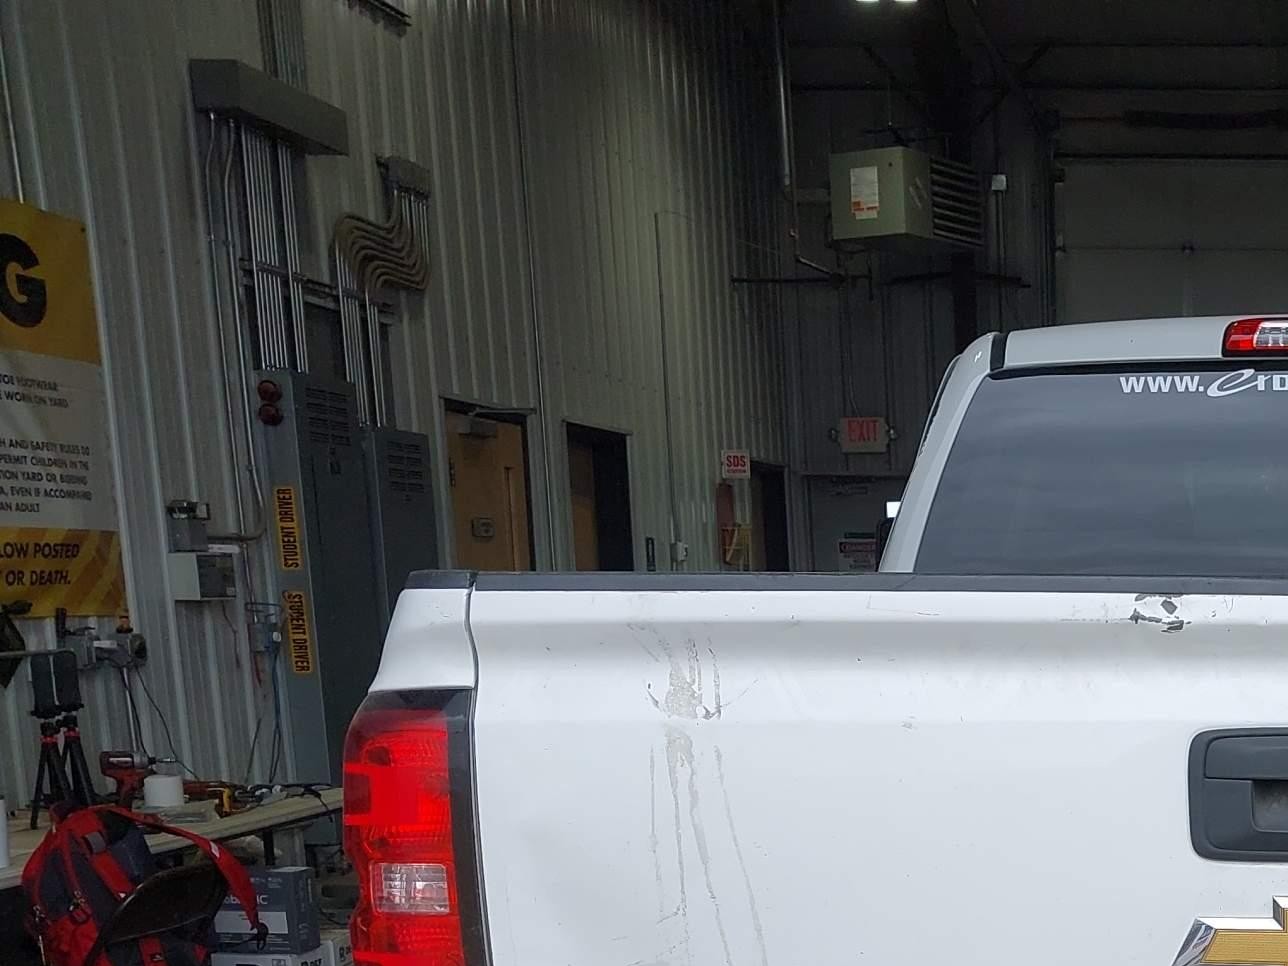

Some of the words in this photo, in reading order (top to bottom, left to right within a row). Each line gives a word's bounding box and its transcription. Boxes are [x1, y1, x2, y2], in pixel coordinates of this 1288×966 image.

[848, 420, 880, 442] EXIT
[9, 438, 29, 449] AND
[30, 456, 68, 469] CHILDREN
[726, 455, 746, 467] SDS
[22, 471, 43, 482] YARD
[46, 473, 58, 485] OR
[10, 486, 32, 497] EVEN
[34, 487, 41, 497] IF
[15, 502, 40, 513] ADULT
[277, 488, 297, 523] DRIVER
[33, 542, 80, 559] POSTED
[281, 525, 300, 569] STUDENT
[5, 570, 25, 586] OR
[30, 570, 71, 585] DEATH.
[287, 592, 307, 636] STUDENT
[293, 637, 311, 673] DRIVER
